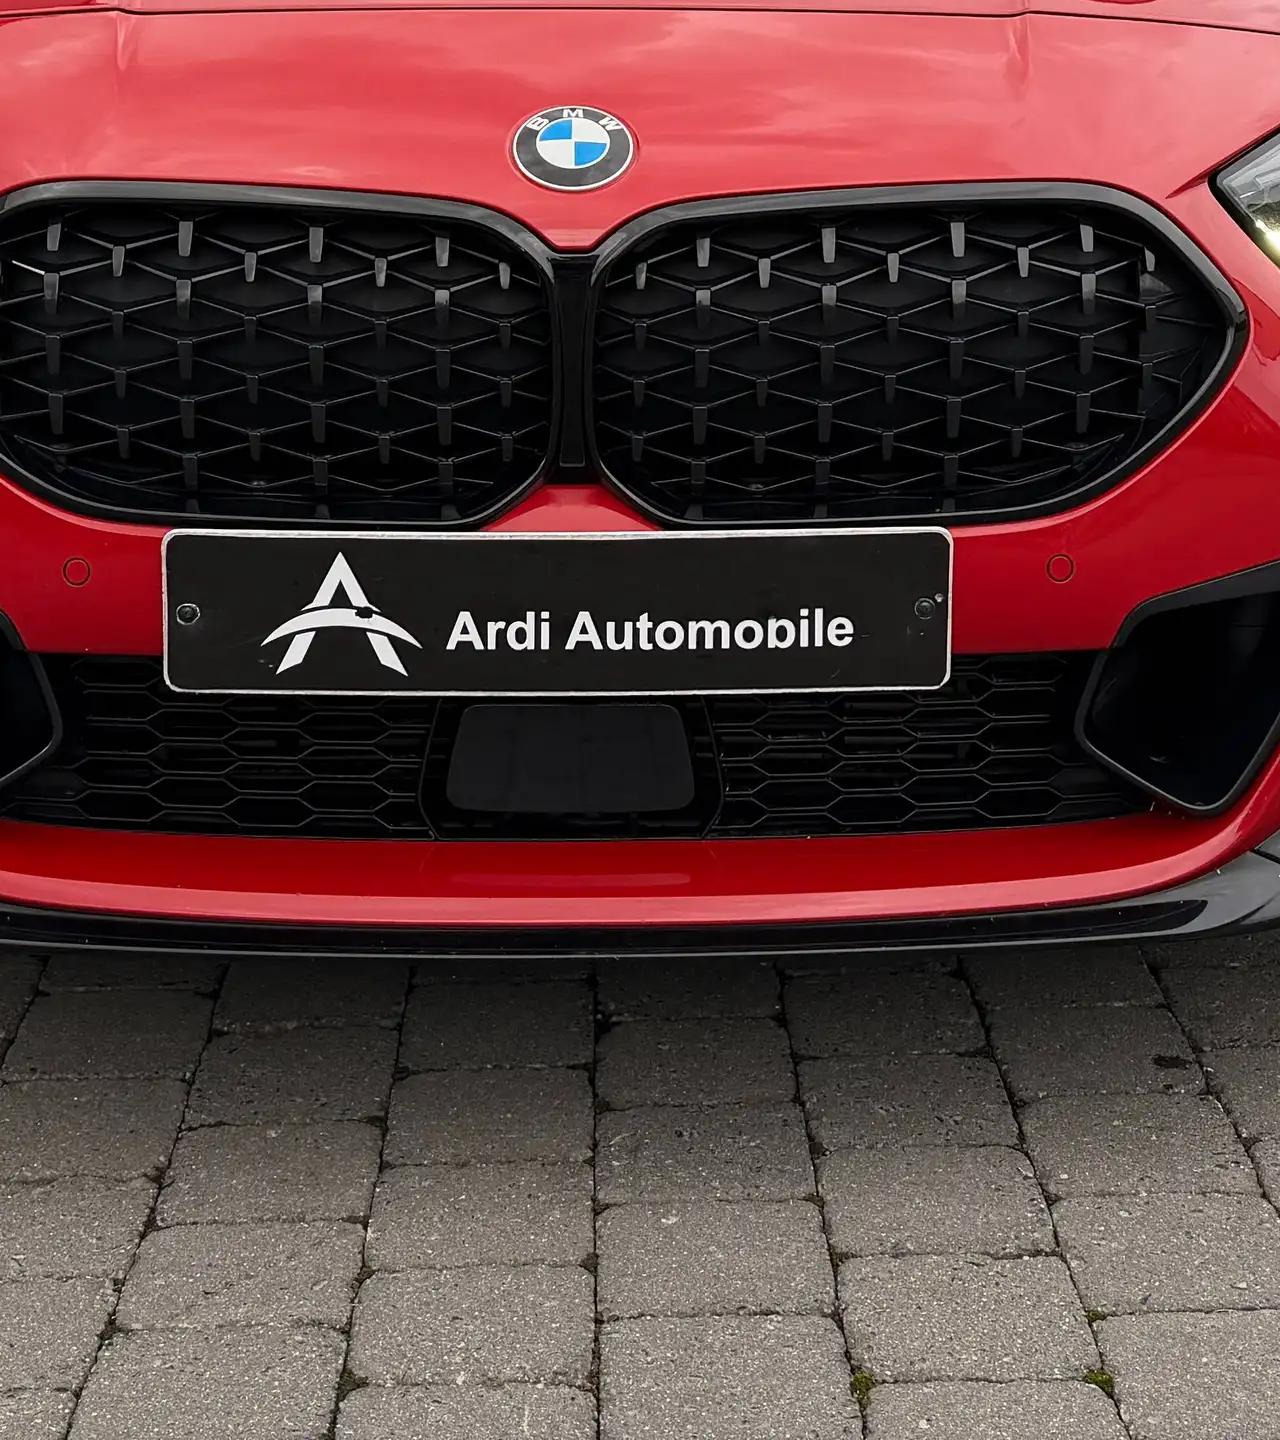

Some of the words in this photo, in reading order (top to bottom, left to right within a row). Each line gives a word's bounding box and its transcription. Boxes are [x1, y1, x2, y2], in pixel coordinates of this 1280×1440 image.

[525, 108, 622, 131] BMW
[446, 610, 550, 651] Ardi
[565, 607, 854, 651] Automobile
